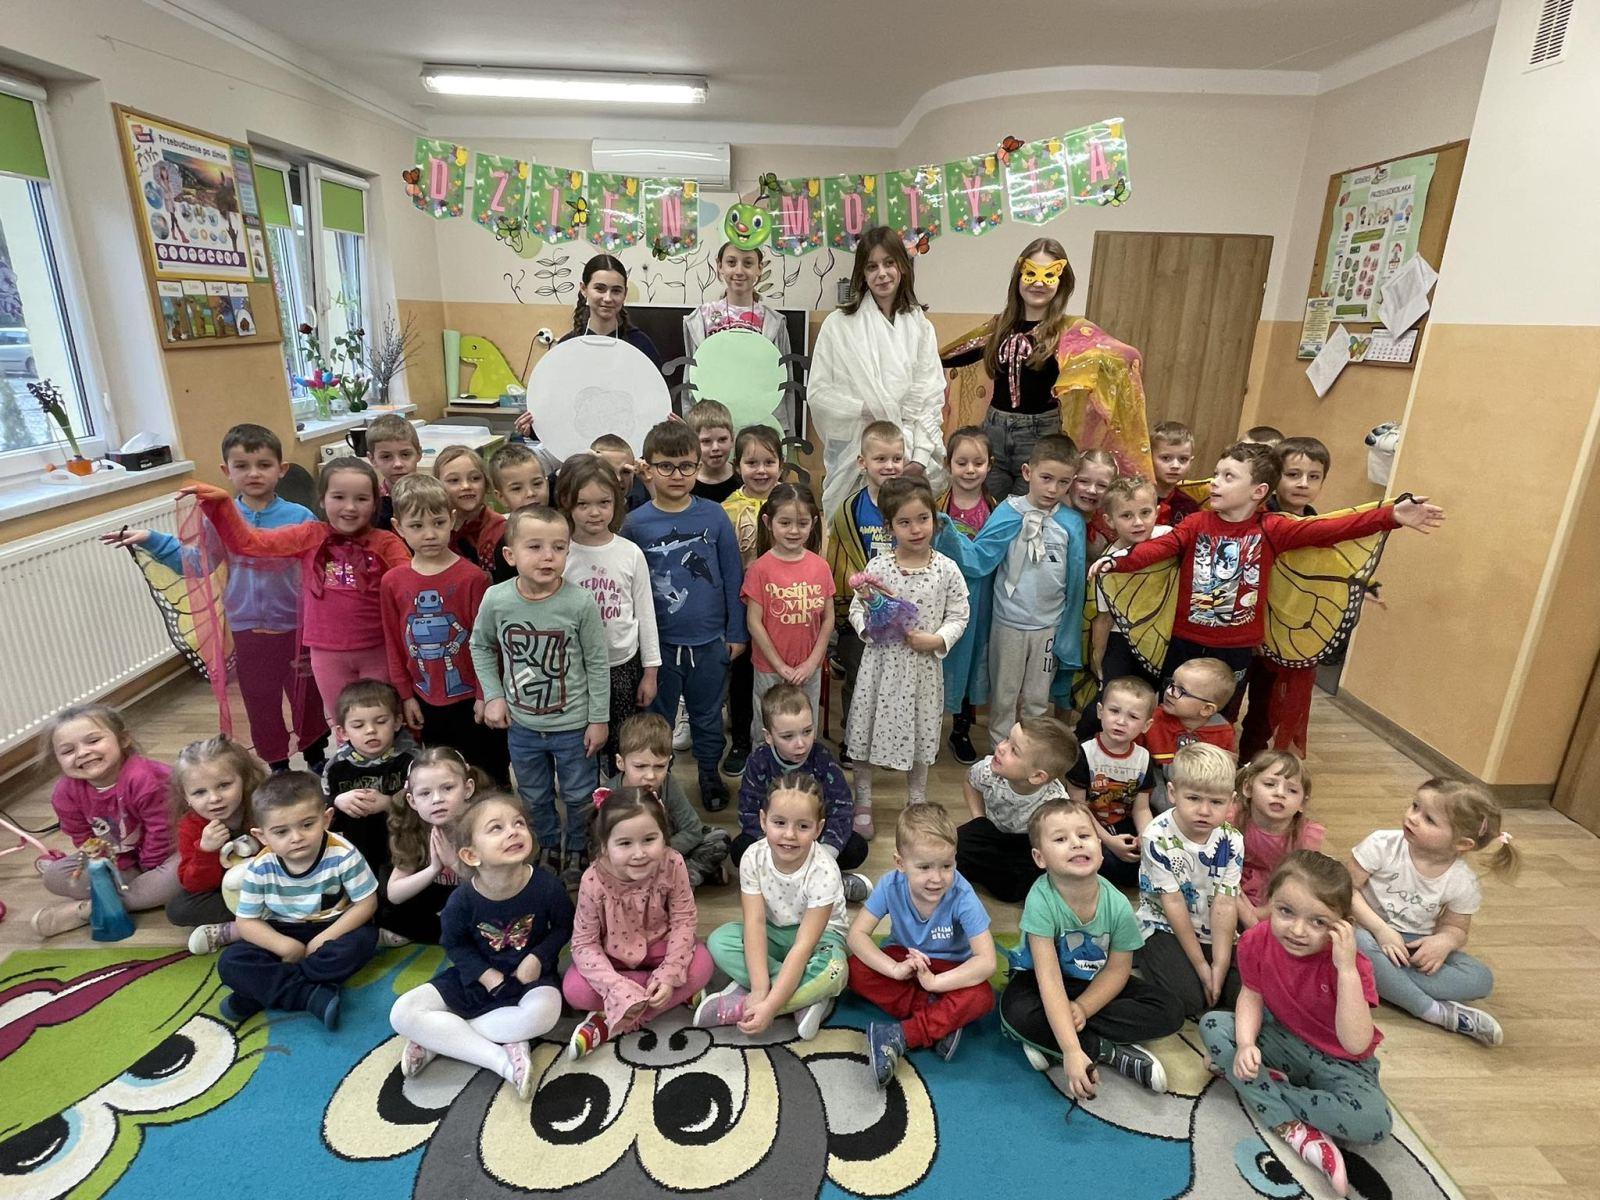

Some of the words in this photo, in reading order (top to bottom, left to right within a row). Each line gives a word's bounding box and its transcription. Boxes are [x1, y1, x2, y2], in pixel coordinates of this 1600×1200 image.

[580, 577, 616, 592] EDNA
[765, 581, 822, 600] Positive
[784, 597, 825, 612] vibes
[780, 611, 812, 628] only
